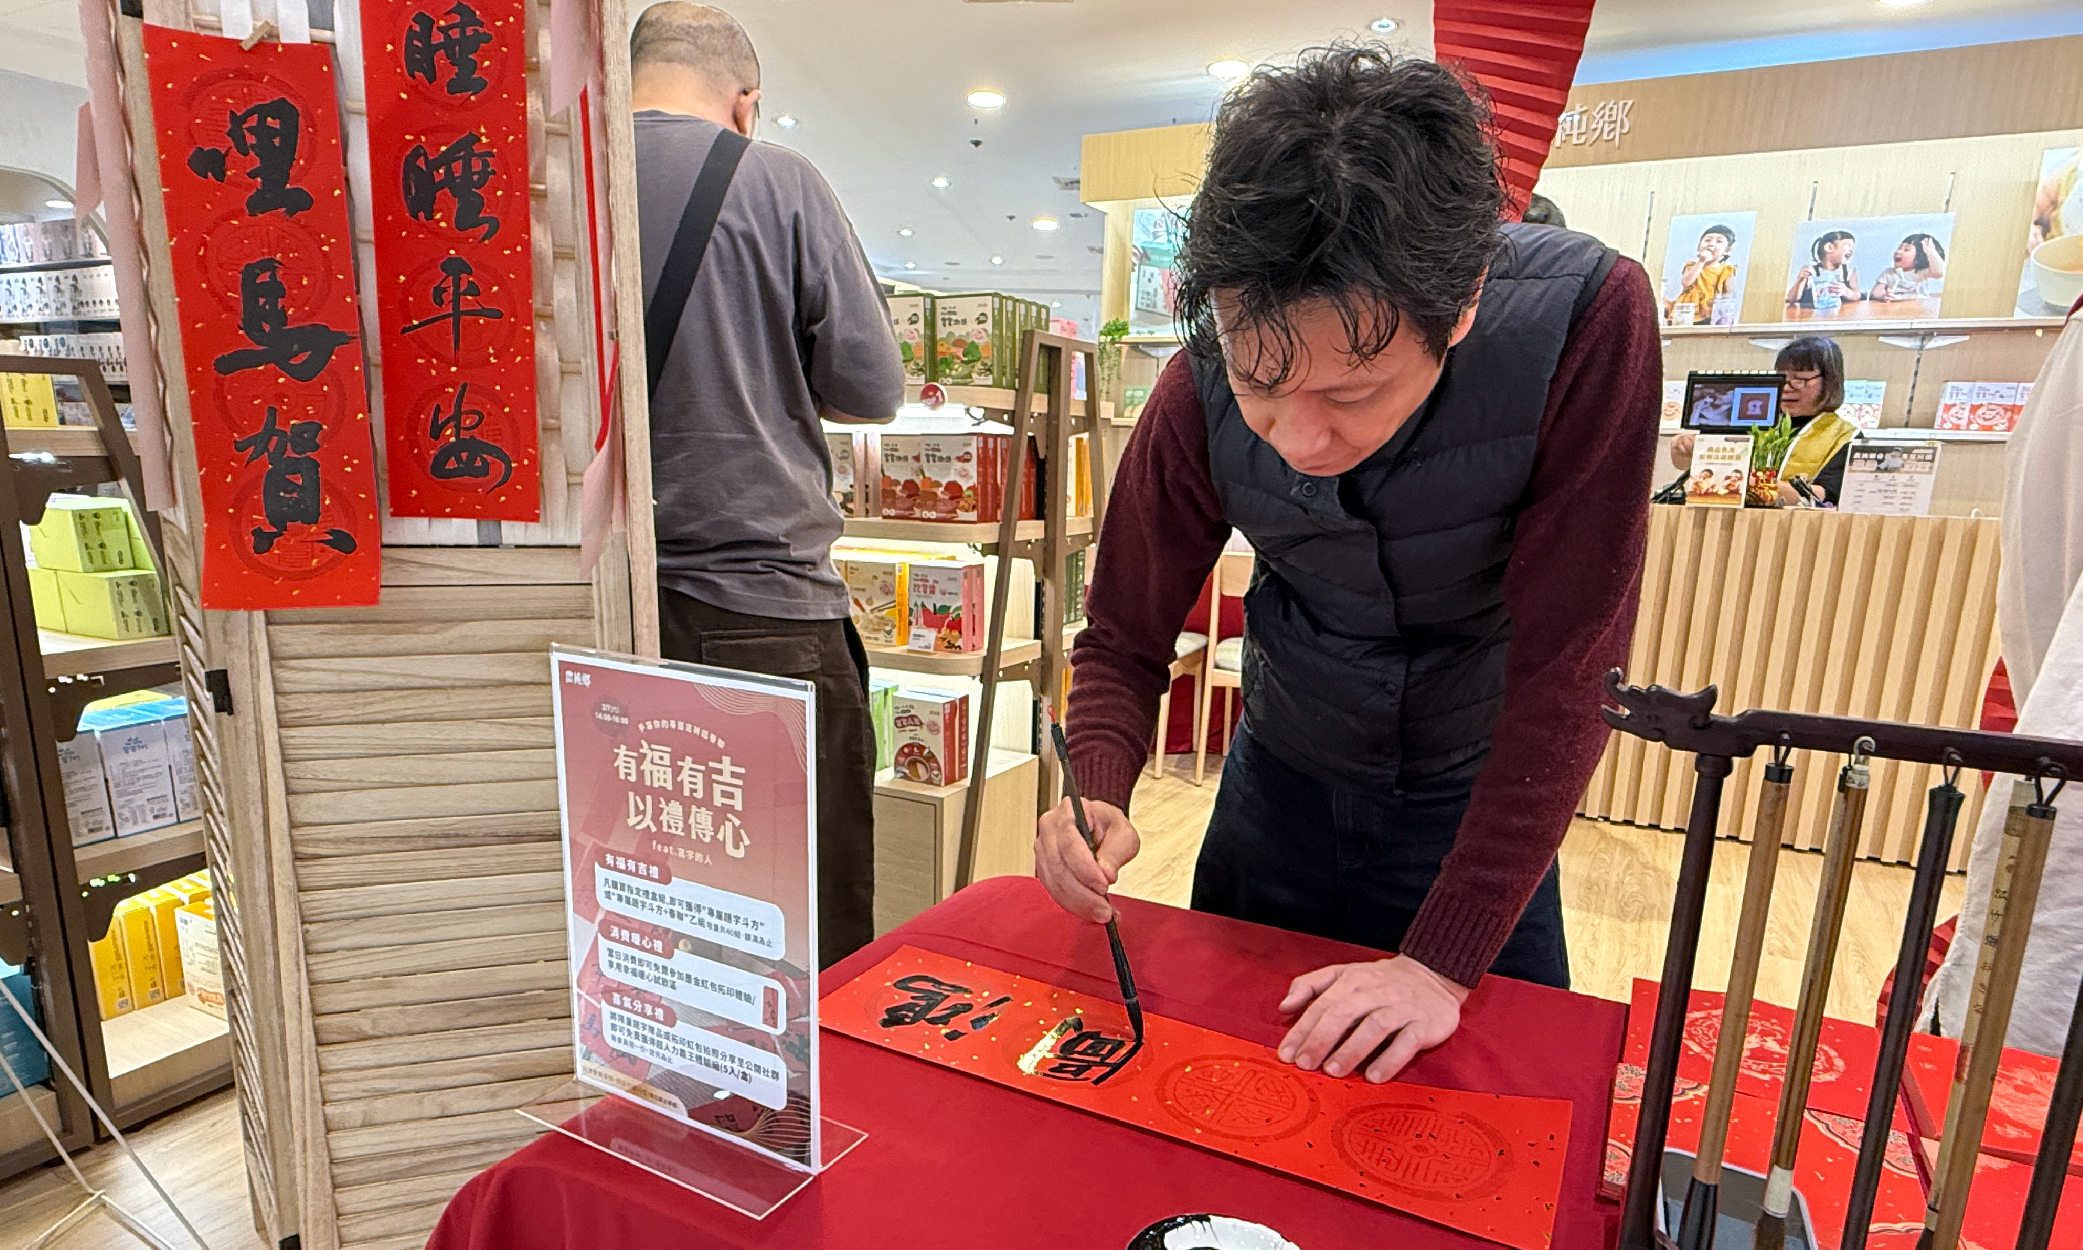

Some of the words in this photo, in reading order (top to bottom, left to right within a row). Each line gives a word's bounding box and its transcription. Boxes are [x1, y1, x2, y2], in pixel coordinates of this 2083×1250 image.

[401, 1, 513, 494] 睡睡平安
[188, 98, 360, 554] 哩馬賀
[613, 739, 746, 812] 有福有吉
[626, 791, 751, 859] 以禮傳心
[605, 853, 660, 880] 有福有吉禮
[609, 925, 664, 954] 消費暖心禮
[612, 992, 665, 1021] 喜氣分享禮
